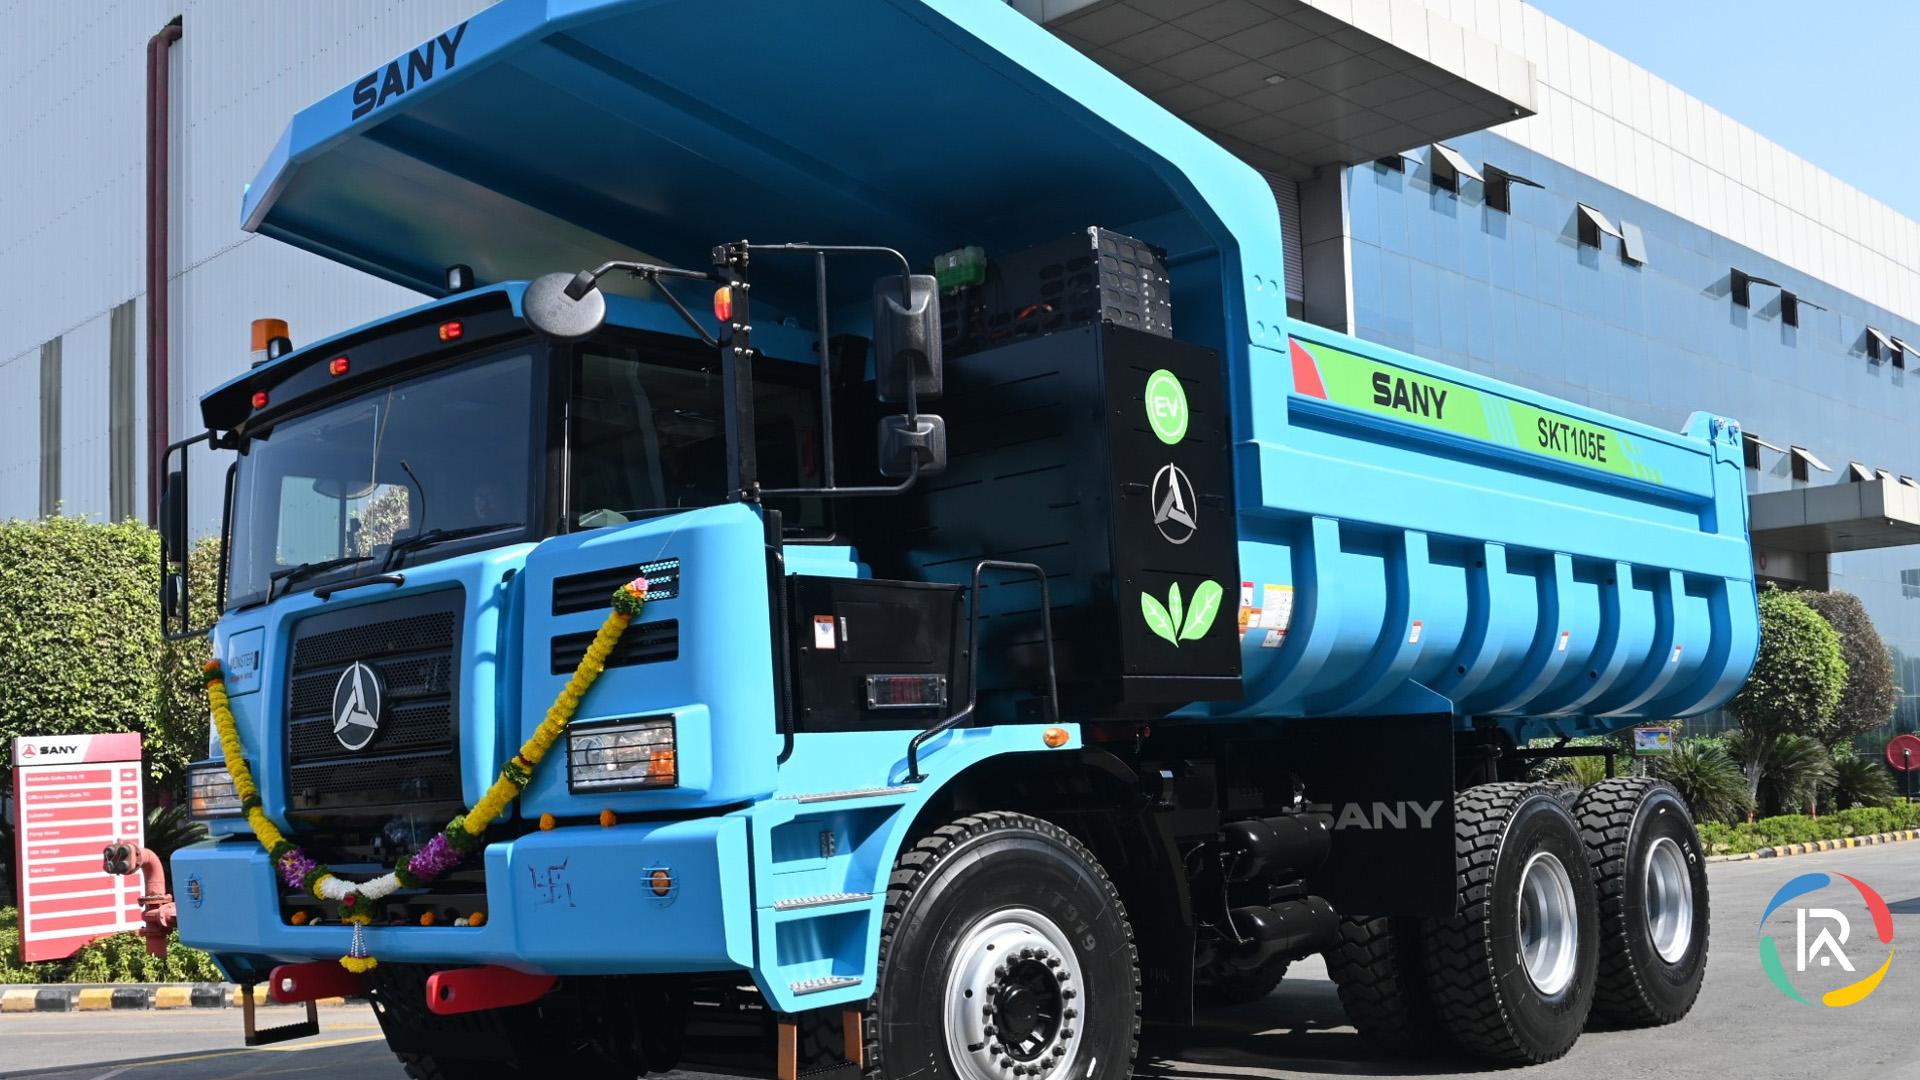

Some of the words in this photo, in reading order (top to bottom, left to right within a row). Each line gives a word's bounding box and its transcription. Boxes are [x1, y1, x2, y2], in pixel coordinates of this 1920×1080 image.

[352, 21, 469, 121] SANY
[1154, 396, 1178, 417] EV
[1372, 371, 1448, 419] SANY
[1537, 417, 1607, 463] SKT105E
[40, 745, 78, 755] SANY
